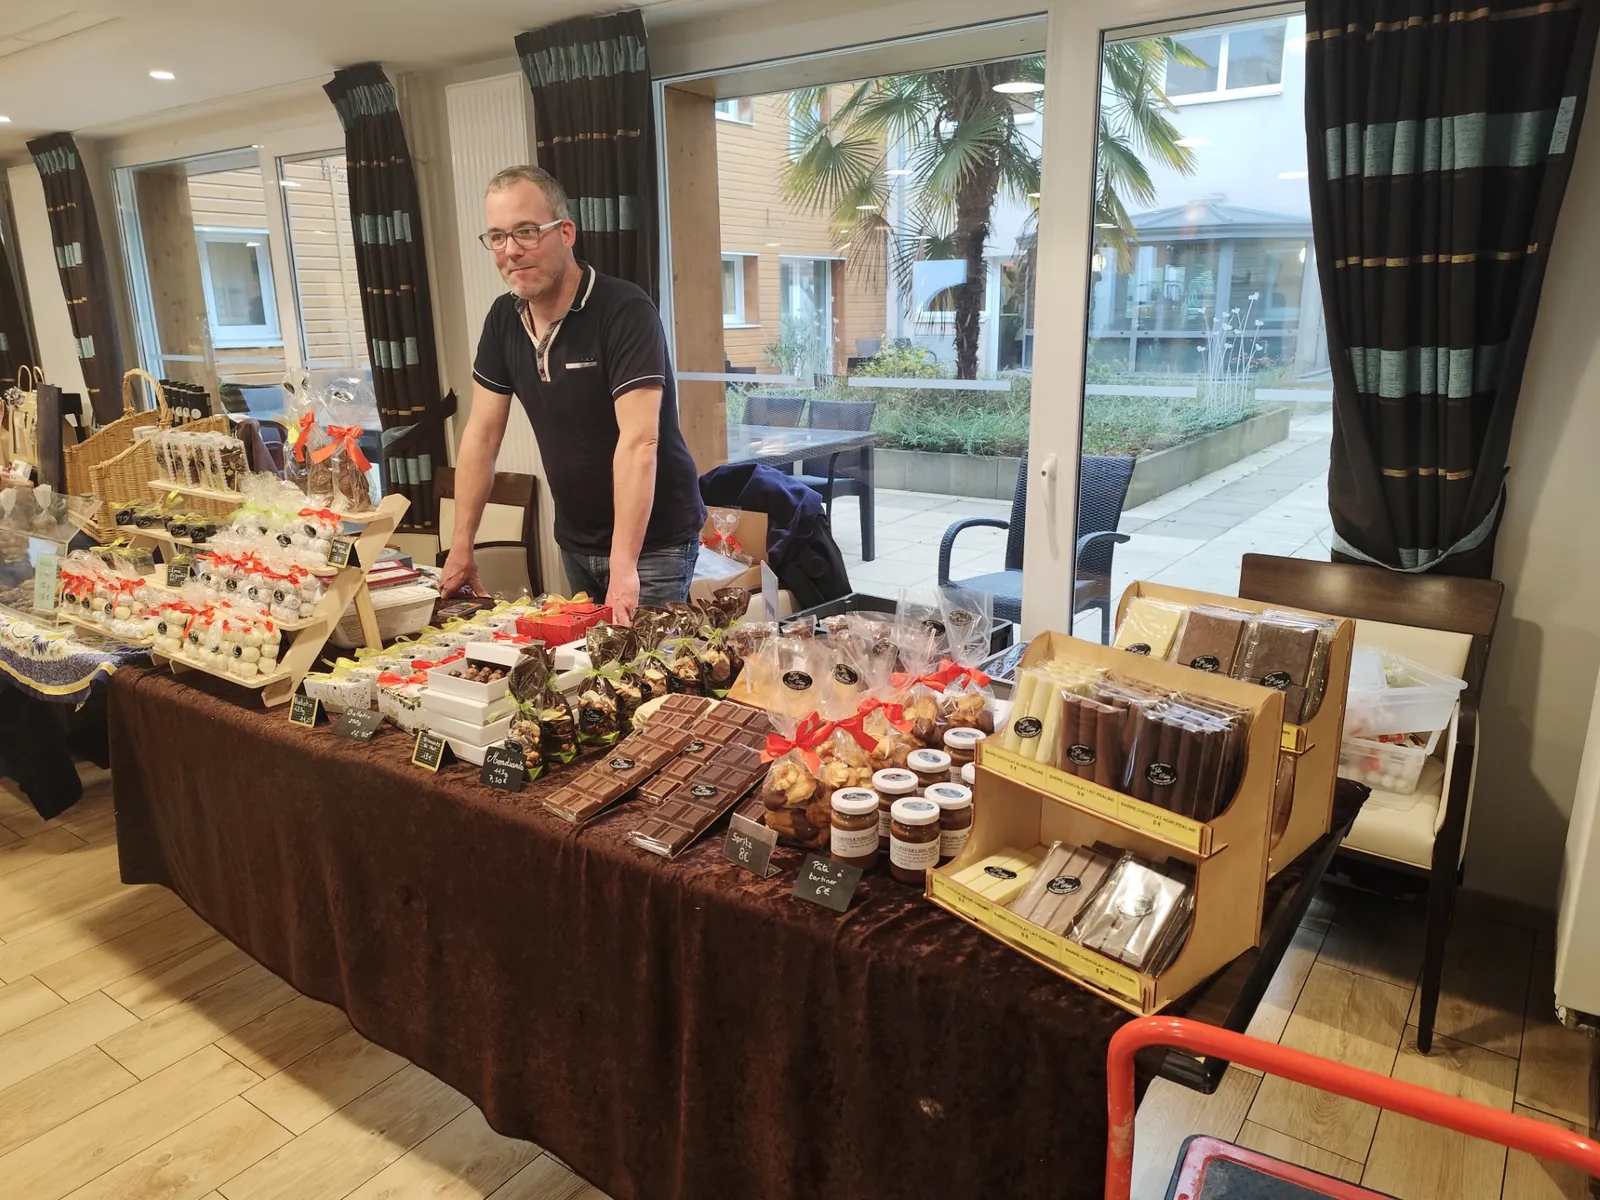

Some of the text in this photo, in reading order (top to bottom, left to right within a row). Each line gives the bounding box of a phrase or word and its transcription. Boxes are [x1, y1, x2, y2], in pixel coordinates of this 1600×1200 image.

[1049, 774, 1063, 783] BARRE
[1064, 779, 1086, 792] CHOCOLAT
[1121, 802, 1136, 811] BARRE
[1137, 808, 1162, 820] CHOCOLAT
[1162, 816, 1175, 825] NOIR
[731, 832, 753, 850] Spritz
[738, 847, 751, 863] 8€
[815, 885, 832, 896] 6€
[1007, 919, 1029, 933] CHOCOLAT
[1065, 947, 1079, 957] BARRE
[1080, 955, 1104, 969] CHOCOLAT
[1104, 966, 1115, 975] NOIR
